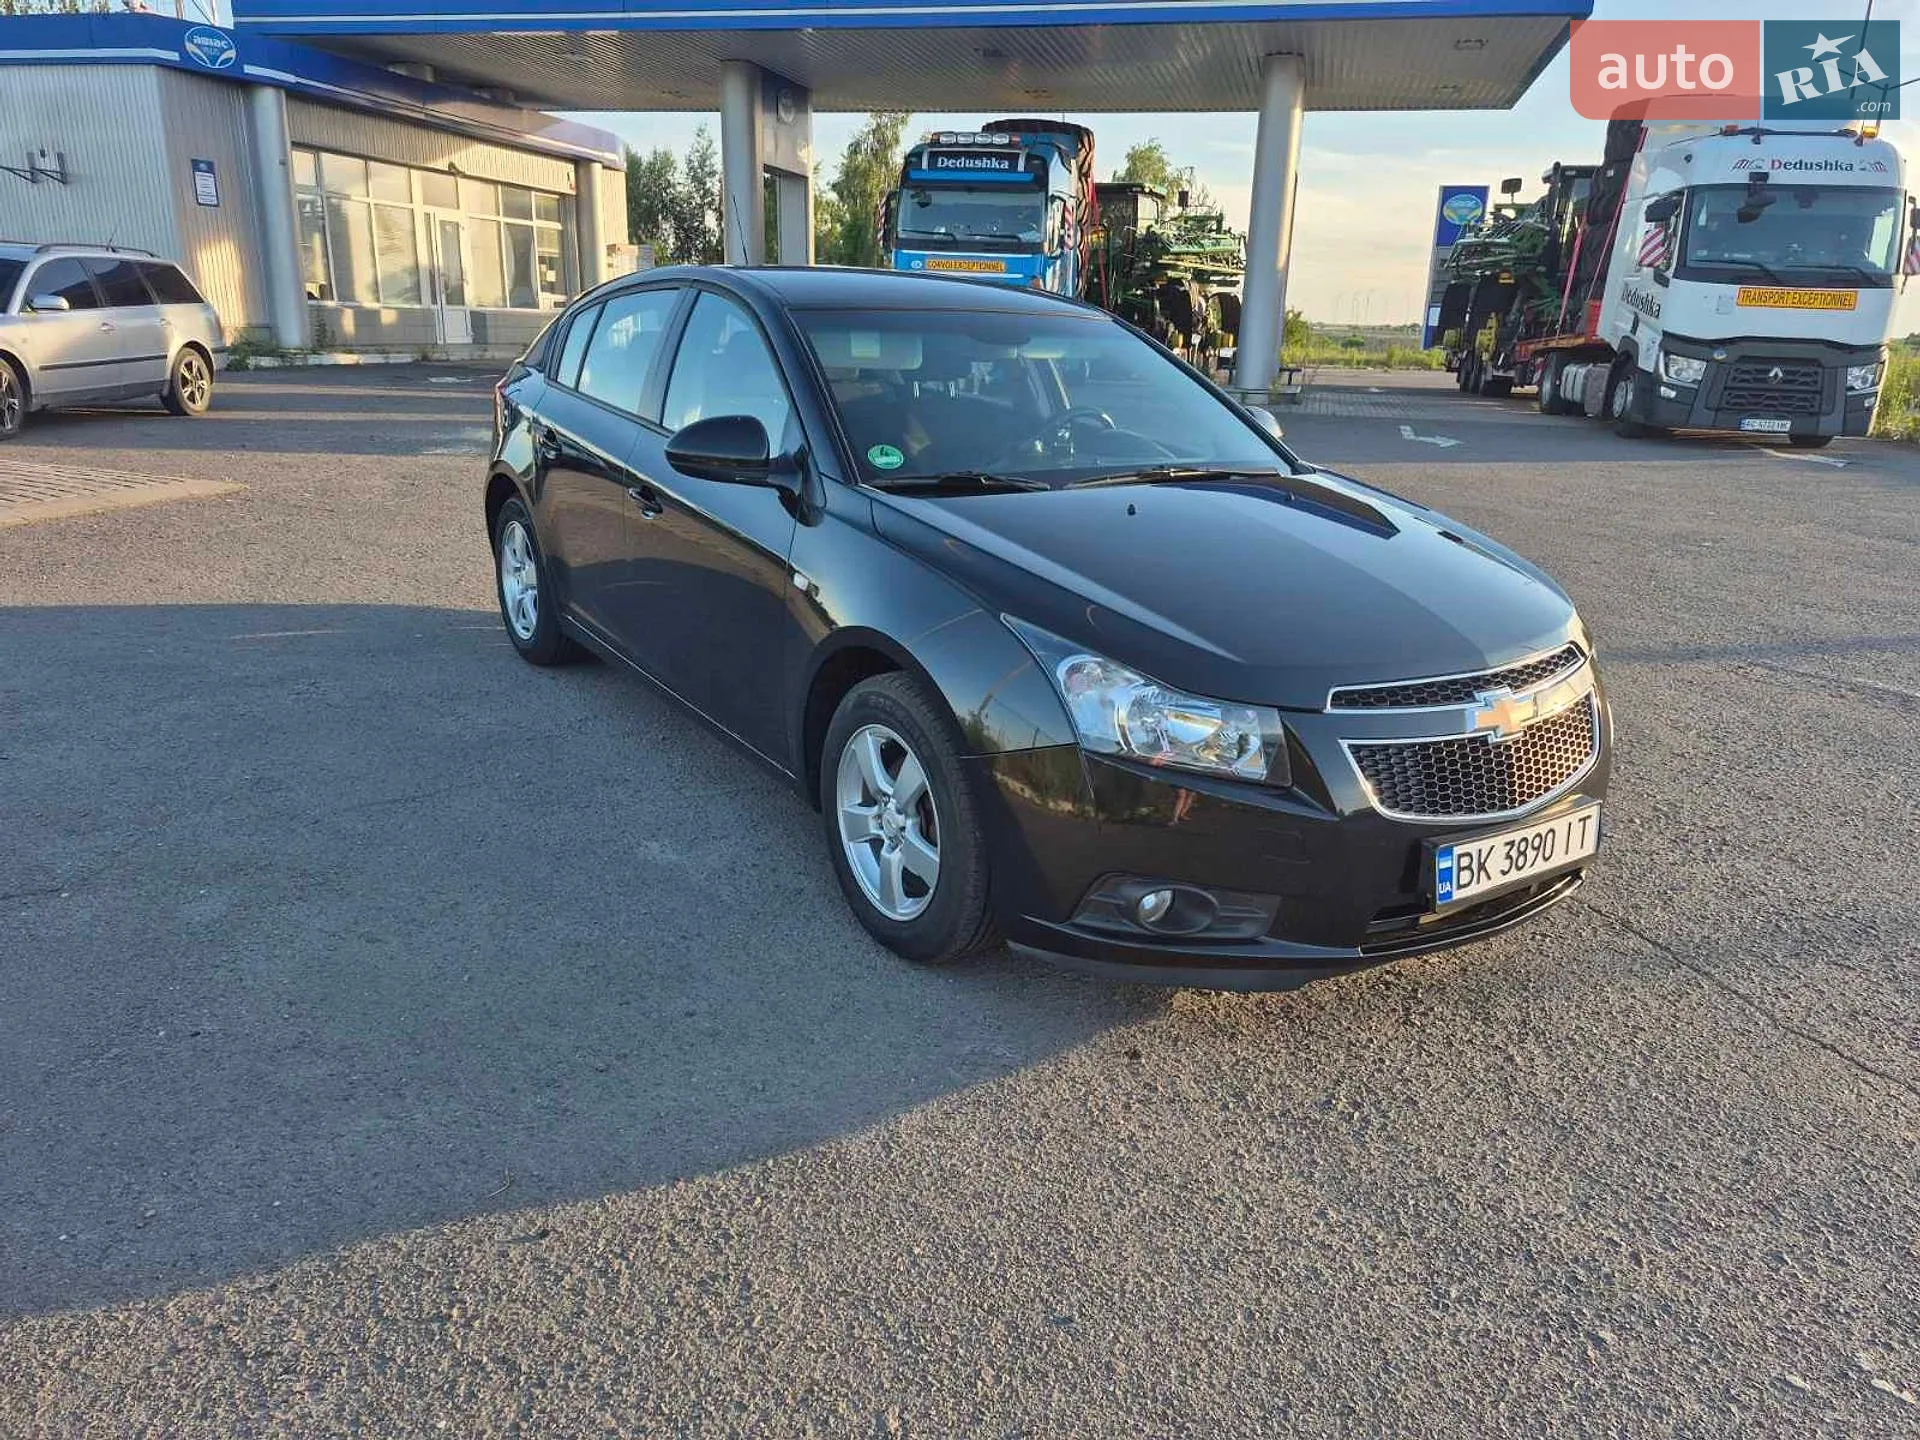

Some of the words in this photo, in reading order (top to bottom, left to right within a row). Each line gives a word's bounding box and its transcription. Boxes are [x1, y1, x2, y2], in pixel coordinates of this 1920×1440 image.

[936, 156, 1009, 169] Dedushka
[1771, 159, 1853, 171] Dedushka
[1621, 287, 1661, 319] Dedushka
[1742, 289, 1791, 305] TRANSPORT
[1456, 845, 1495, 890] BK
[1500, 828, 1556, 876] 3890
[1438, 882, 1452, 893] UA
